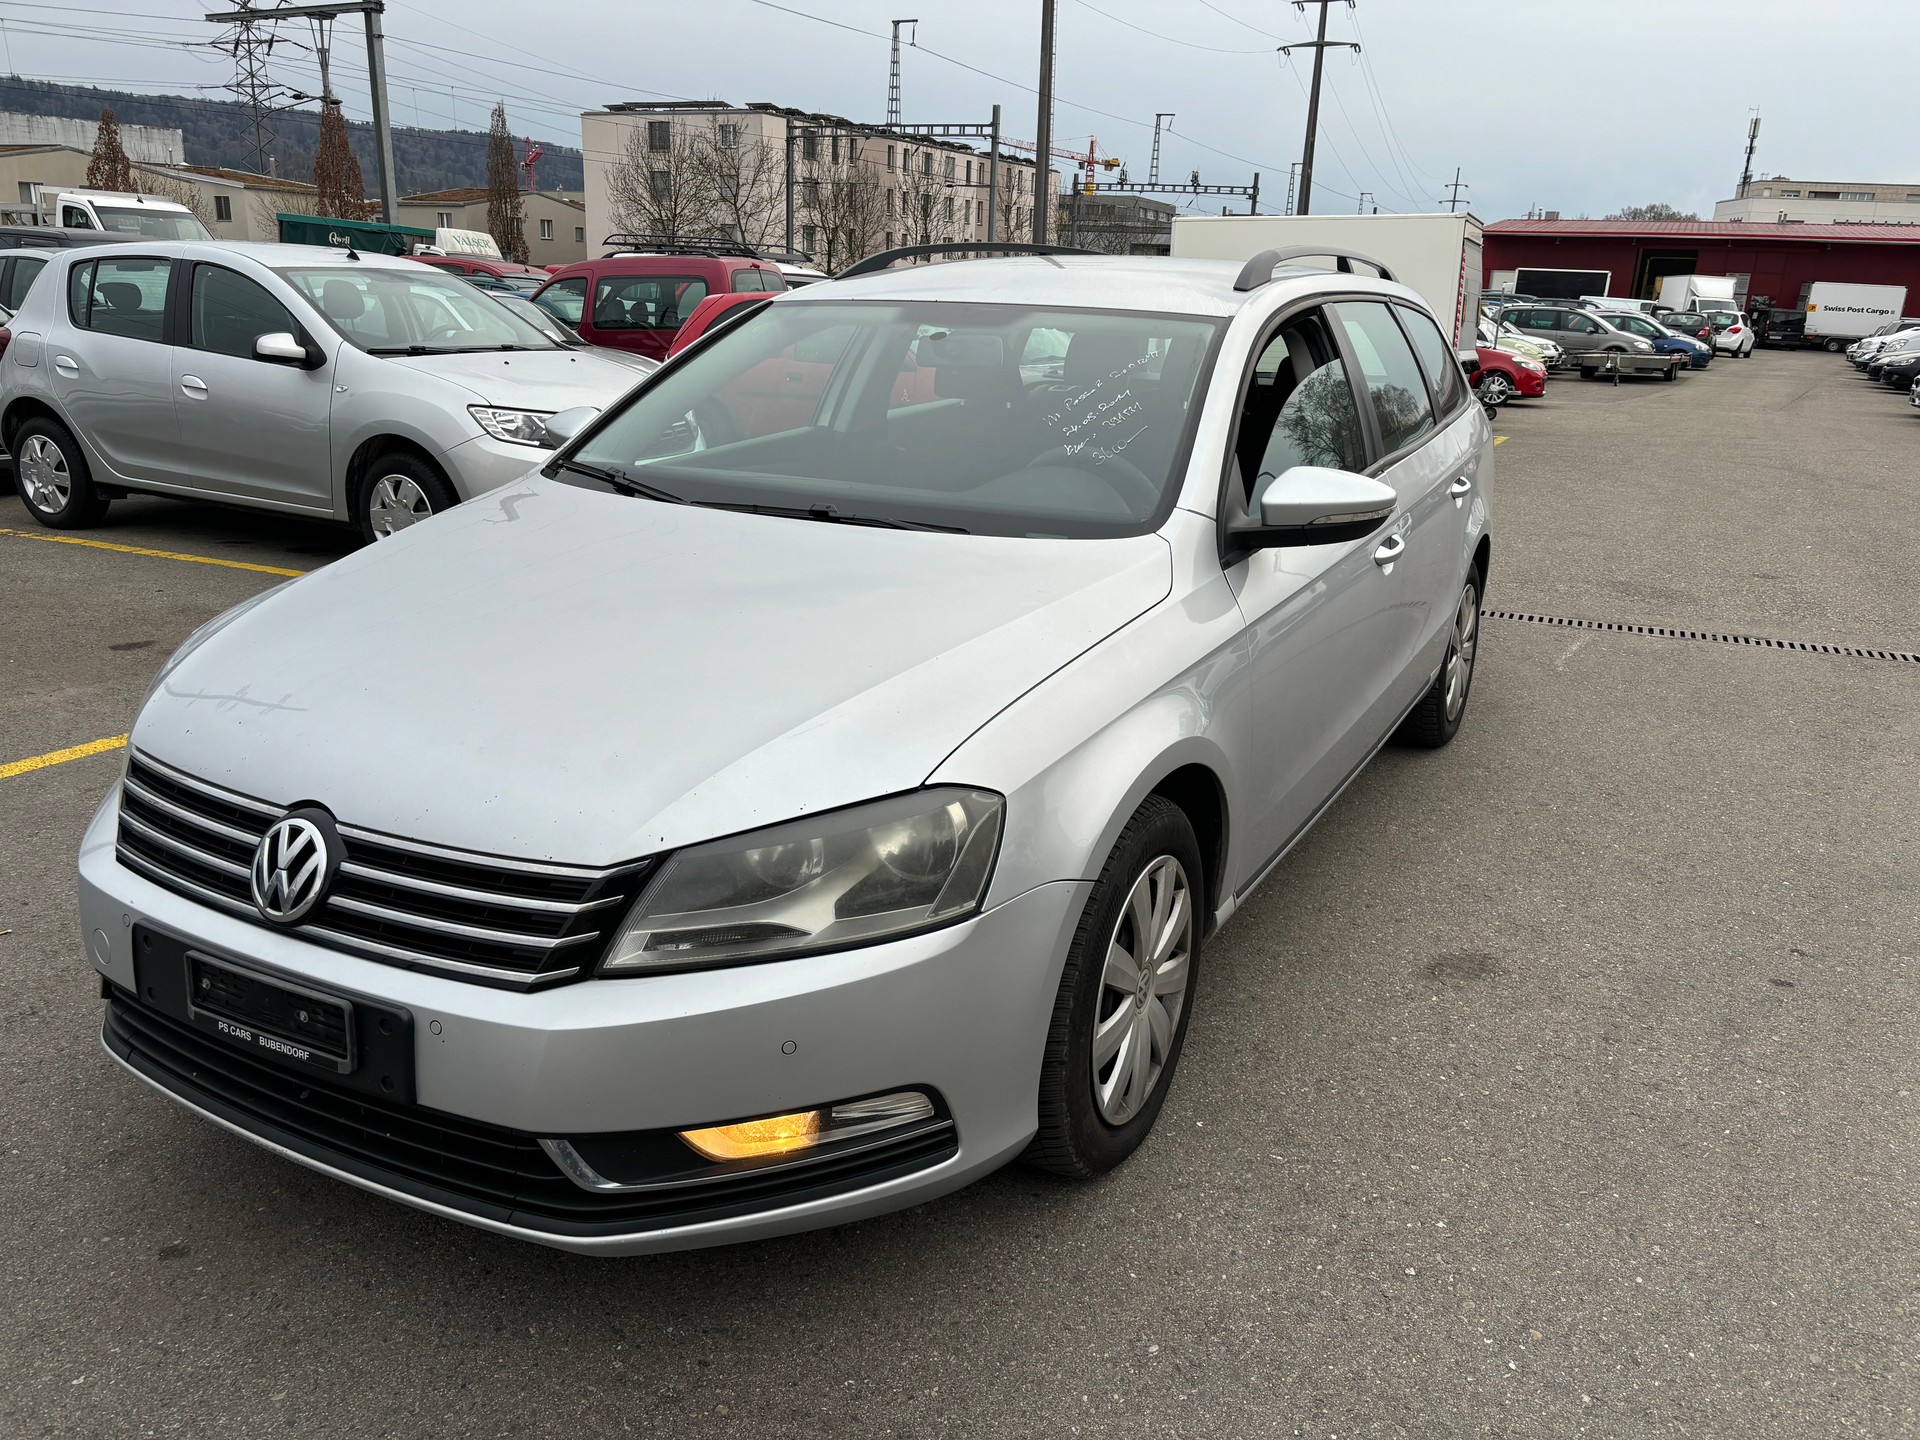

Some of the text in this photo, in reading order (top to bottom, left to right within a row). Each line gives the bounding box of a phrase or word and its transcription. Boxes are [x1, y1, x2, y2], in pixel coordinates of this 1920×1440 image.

[452, 235, 490, 249] VALSER
[1823, 305, 1890, 316] Swiss Post Cargo
[217, 1021, 311, 1061] PS CARS BUBENDORF
